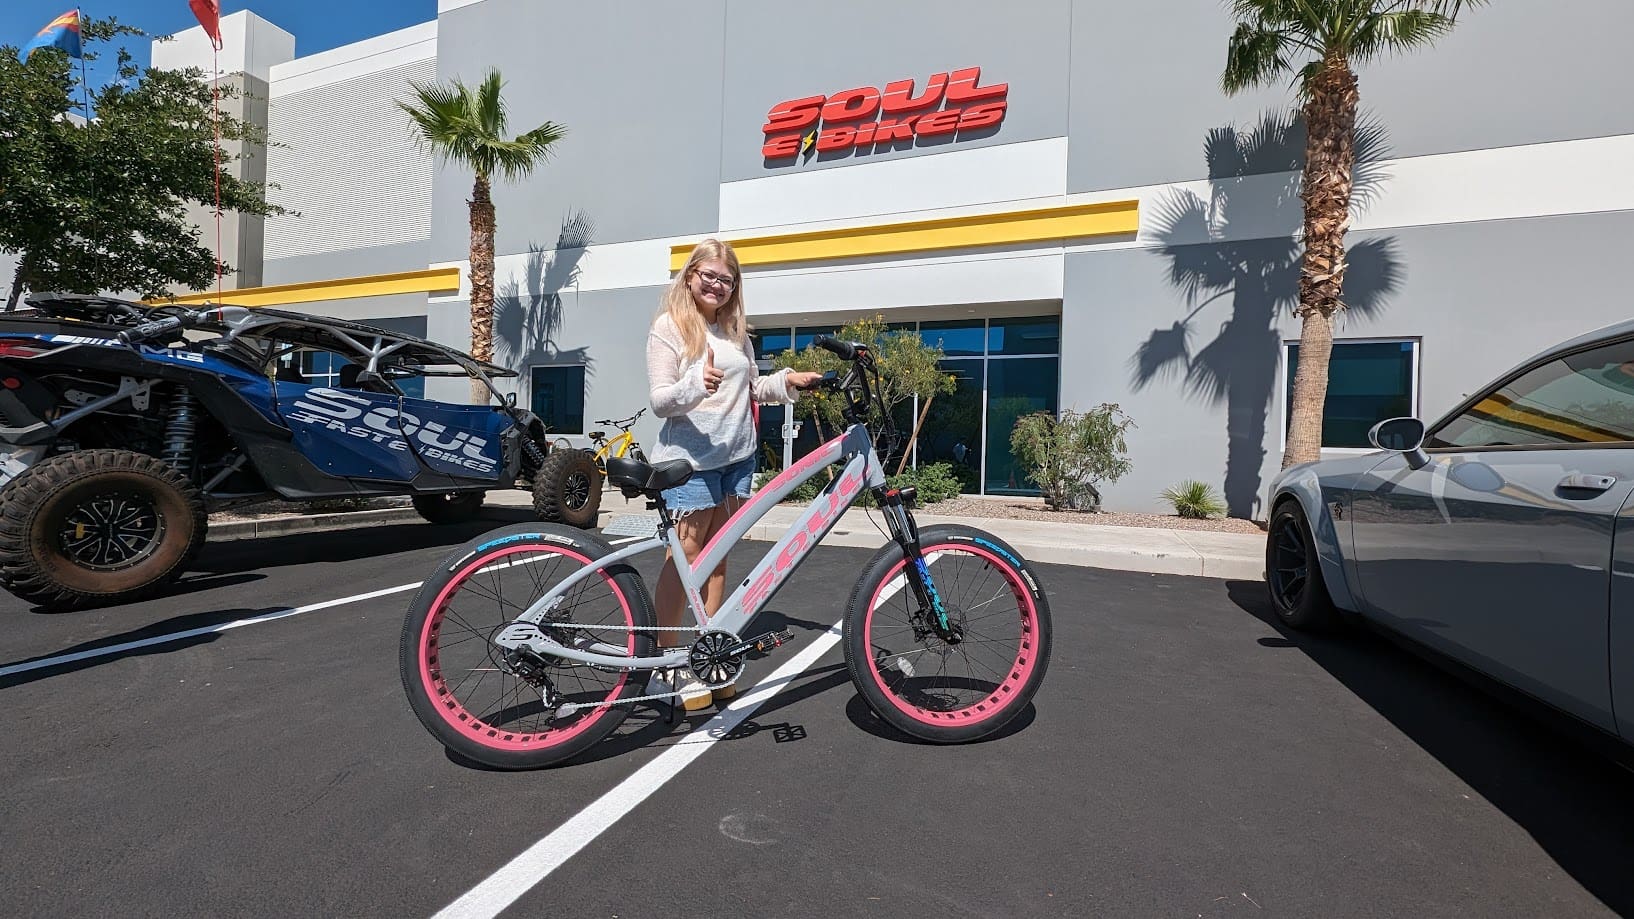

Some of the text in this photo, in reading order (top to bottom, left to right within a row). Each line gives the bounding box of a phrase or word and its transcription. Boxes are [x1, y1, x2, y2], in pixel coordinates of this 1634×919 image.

[762, 66, 1008, 133] SOUL
[286, 410, 391, 442] FAST
[293, 387, 497, 465] SOUL
[741, 463, 872, 607] SOUL
